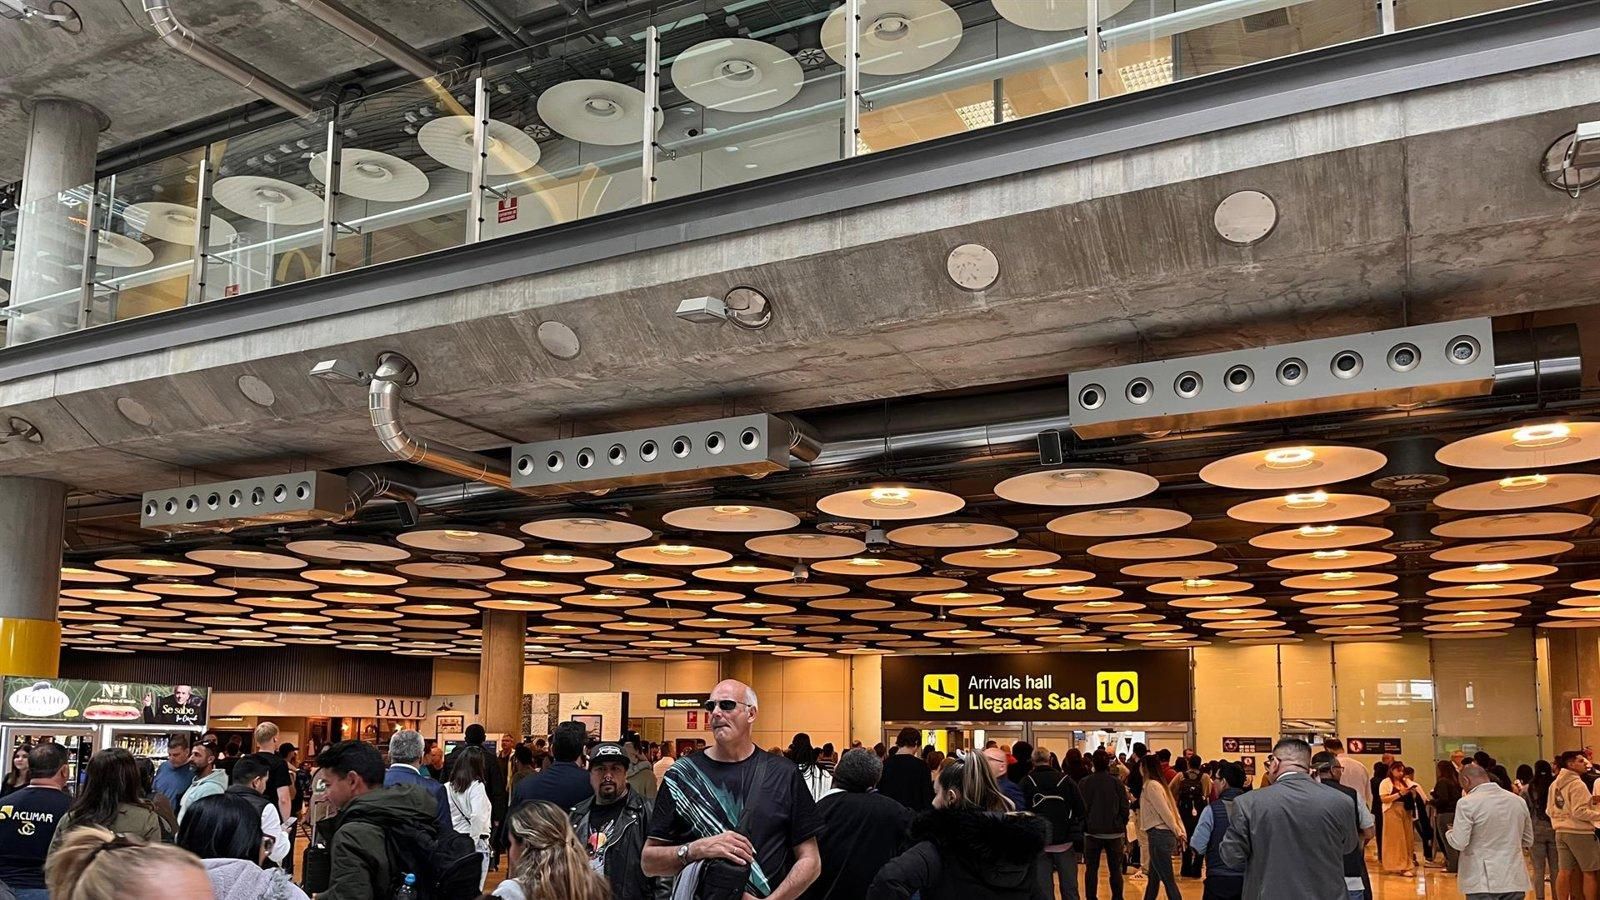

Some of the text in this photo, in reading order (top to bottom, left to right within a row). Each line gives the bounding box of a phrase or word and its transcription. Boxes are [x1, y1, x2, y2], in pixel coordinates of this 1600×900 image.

[968, 675, 1052, 690] Arrivals hall
[15, 694, 64, 705] LEGADO
[1101, 679, 1134, 704] 10
[375, 698, 426, 718] PAUL
[969, 693, 1086, 714] Llegadas Sala
[12, 811, 54, 823] ACLIMAR
